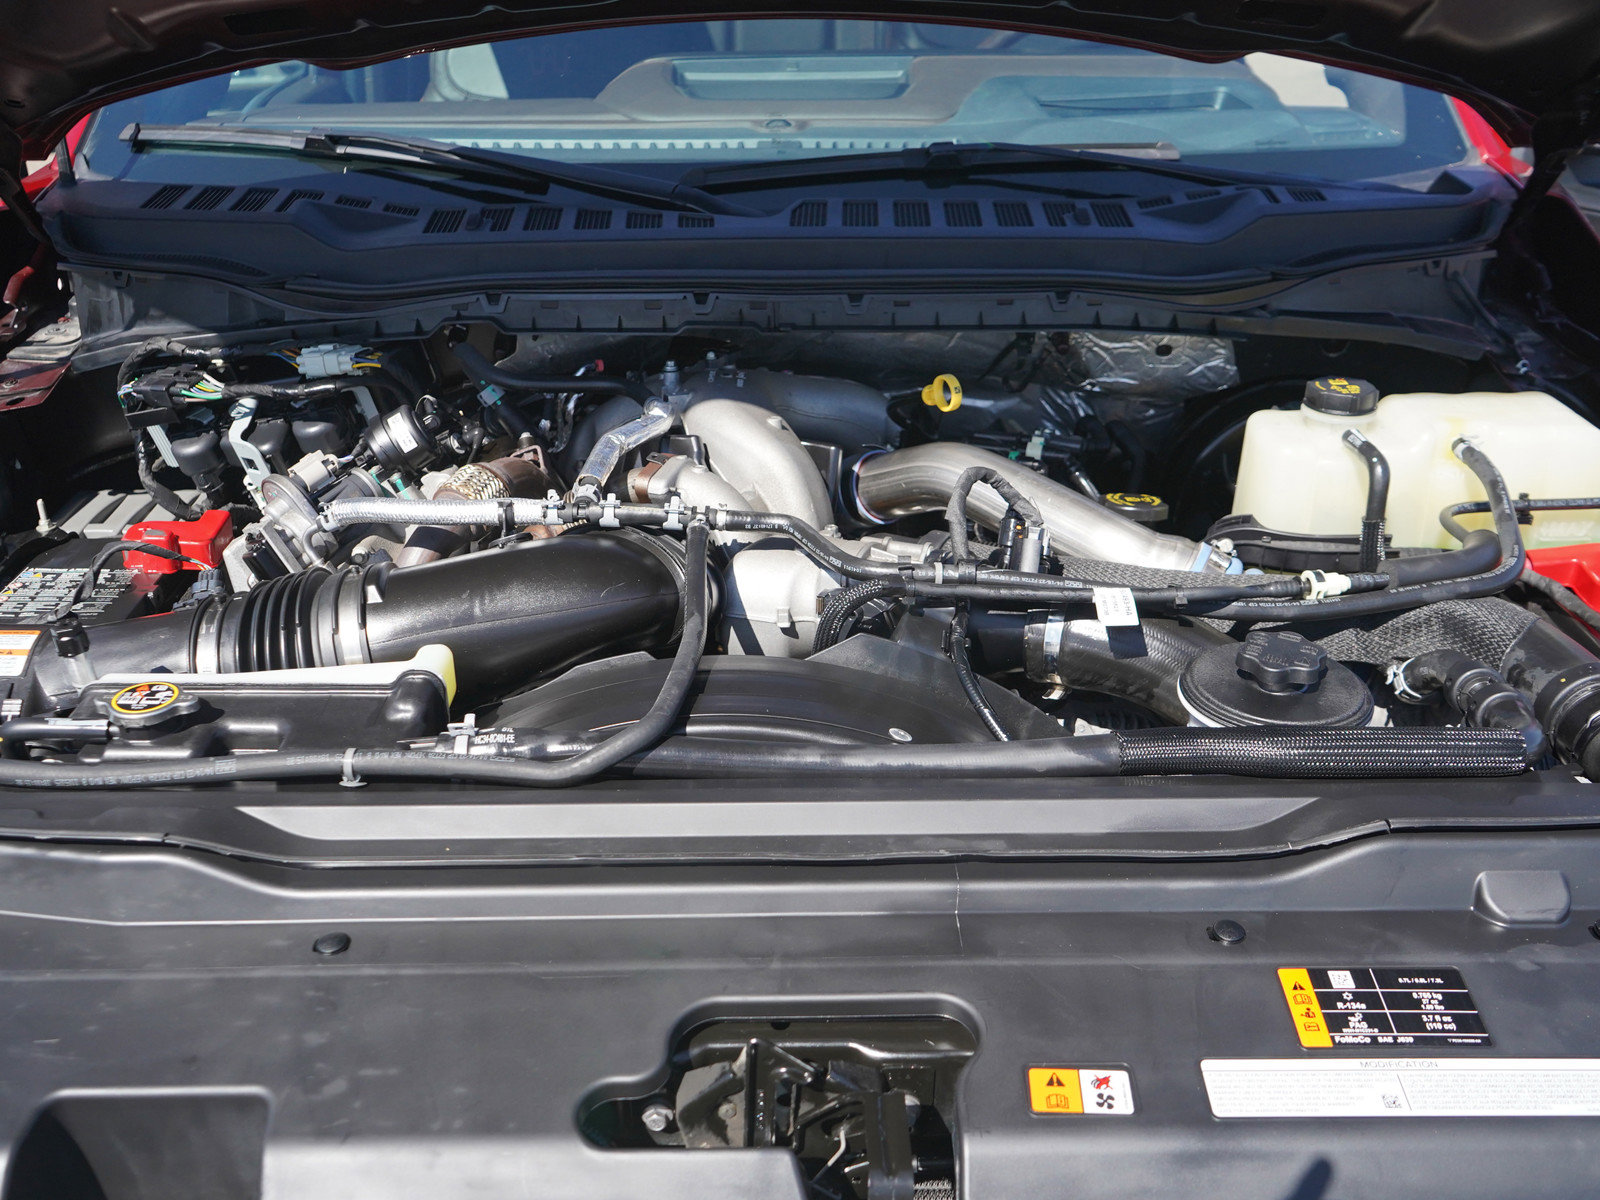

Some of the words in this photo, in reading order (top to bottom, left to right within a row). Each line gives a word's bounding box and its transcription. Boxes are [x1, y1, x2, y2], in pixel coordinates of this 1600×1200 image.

[1336, 1002, 1367, 1010] R-134a
[1421, 1014, 1434, 1022] 3.7
[1348, 1021, 1369, 1029] PAG
[1334, 1035, 1372, 1043] FoMoCo
[1359, 1060, 1439, 1068] MODIFICATION
